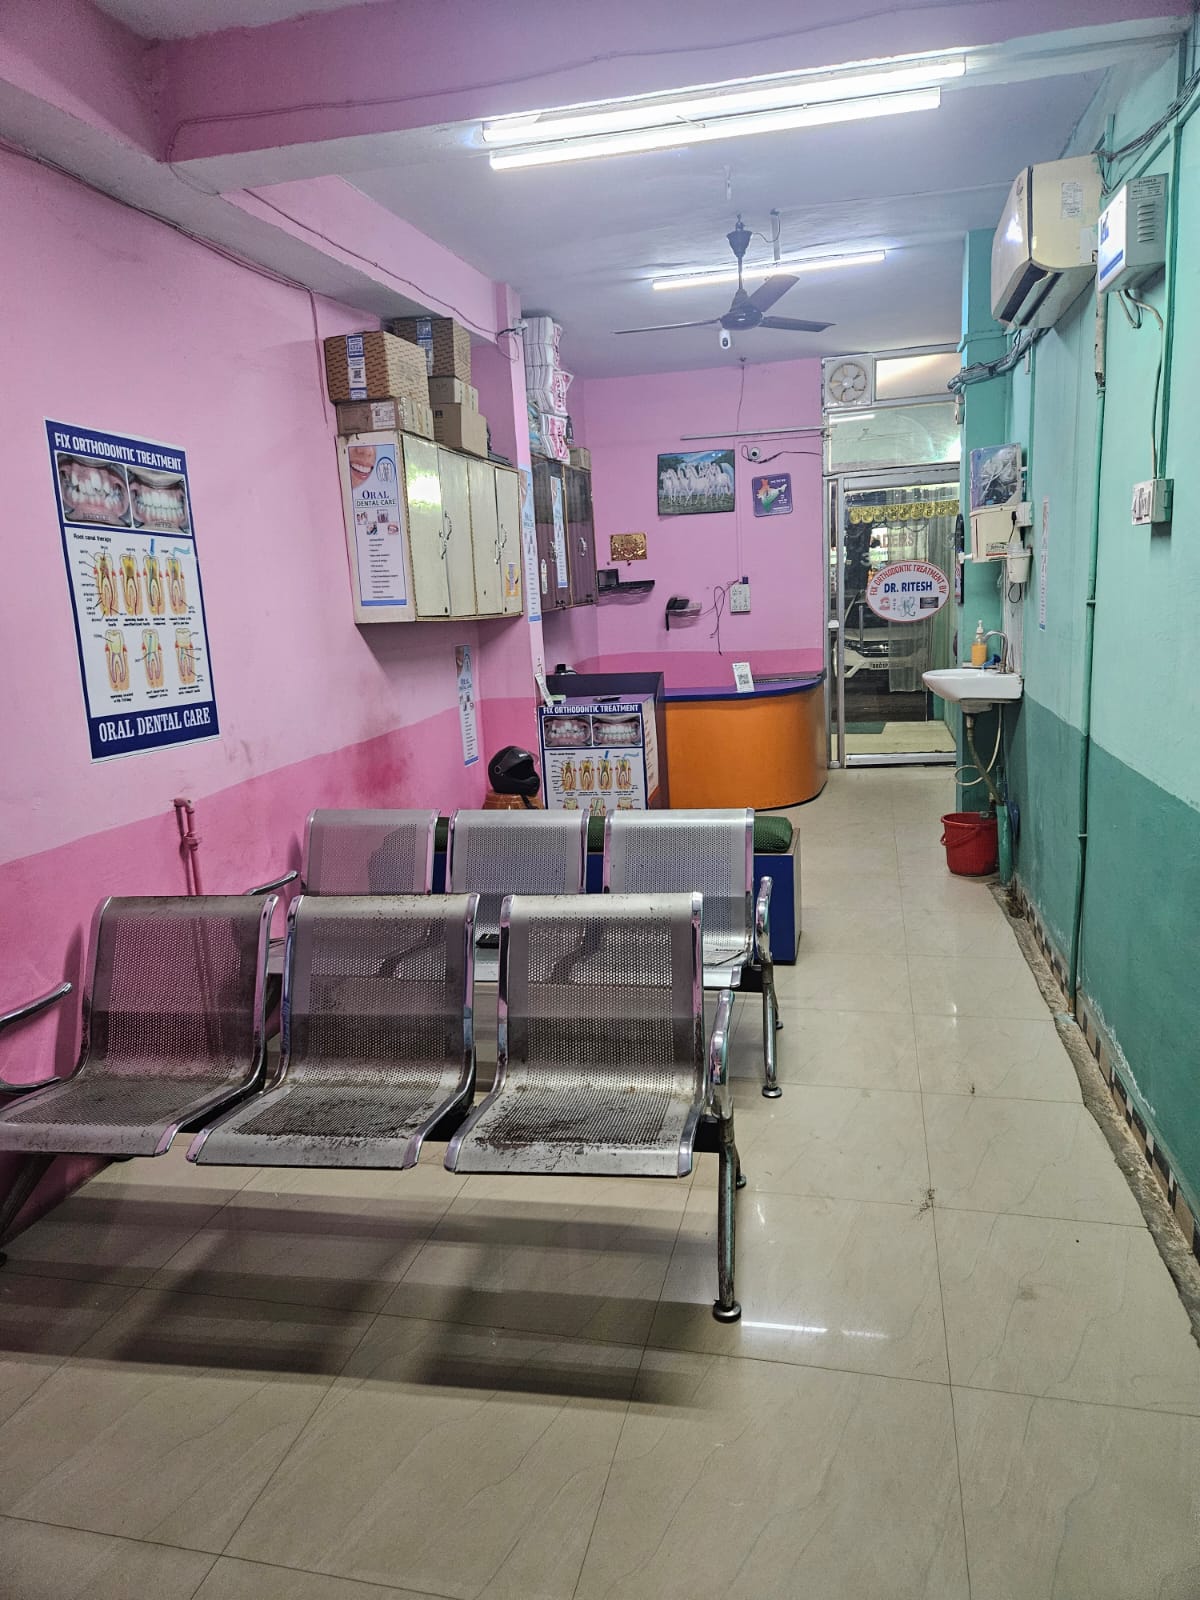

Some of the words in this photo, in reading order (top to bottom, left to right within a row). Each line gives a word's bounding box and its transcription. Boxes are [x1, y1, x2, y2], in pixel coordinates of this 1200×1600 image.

[54, 432, 71, 449] FIX
[72, 436, 135, 462] ORTHODONTIC
[135, 449, 182, 471] TREATMENT
[362, 489, 390, 500] ORAL
[874, 564, 912, 586] ORTHODONTIC
[913, 564, 945, 585] TREATMENT
[884, 583, 899, 593] DR.
[901, 581, 933, 592] RITESH
[554, 705, 599, 714] ORTHODONTIC
[600, 704, 639, 713] TREATMENT
[98, 719, 135, 743] ORAL
[136, 711, 182, 736] DENTAL
[183, 707, 211, 728] CARE
